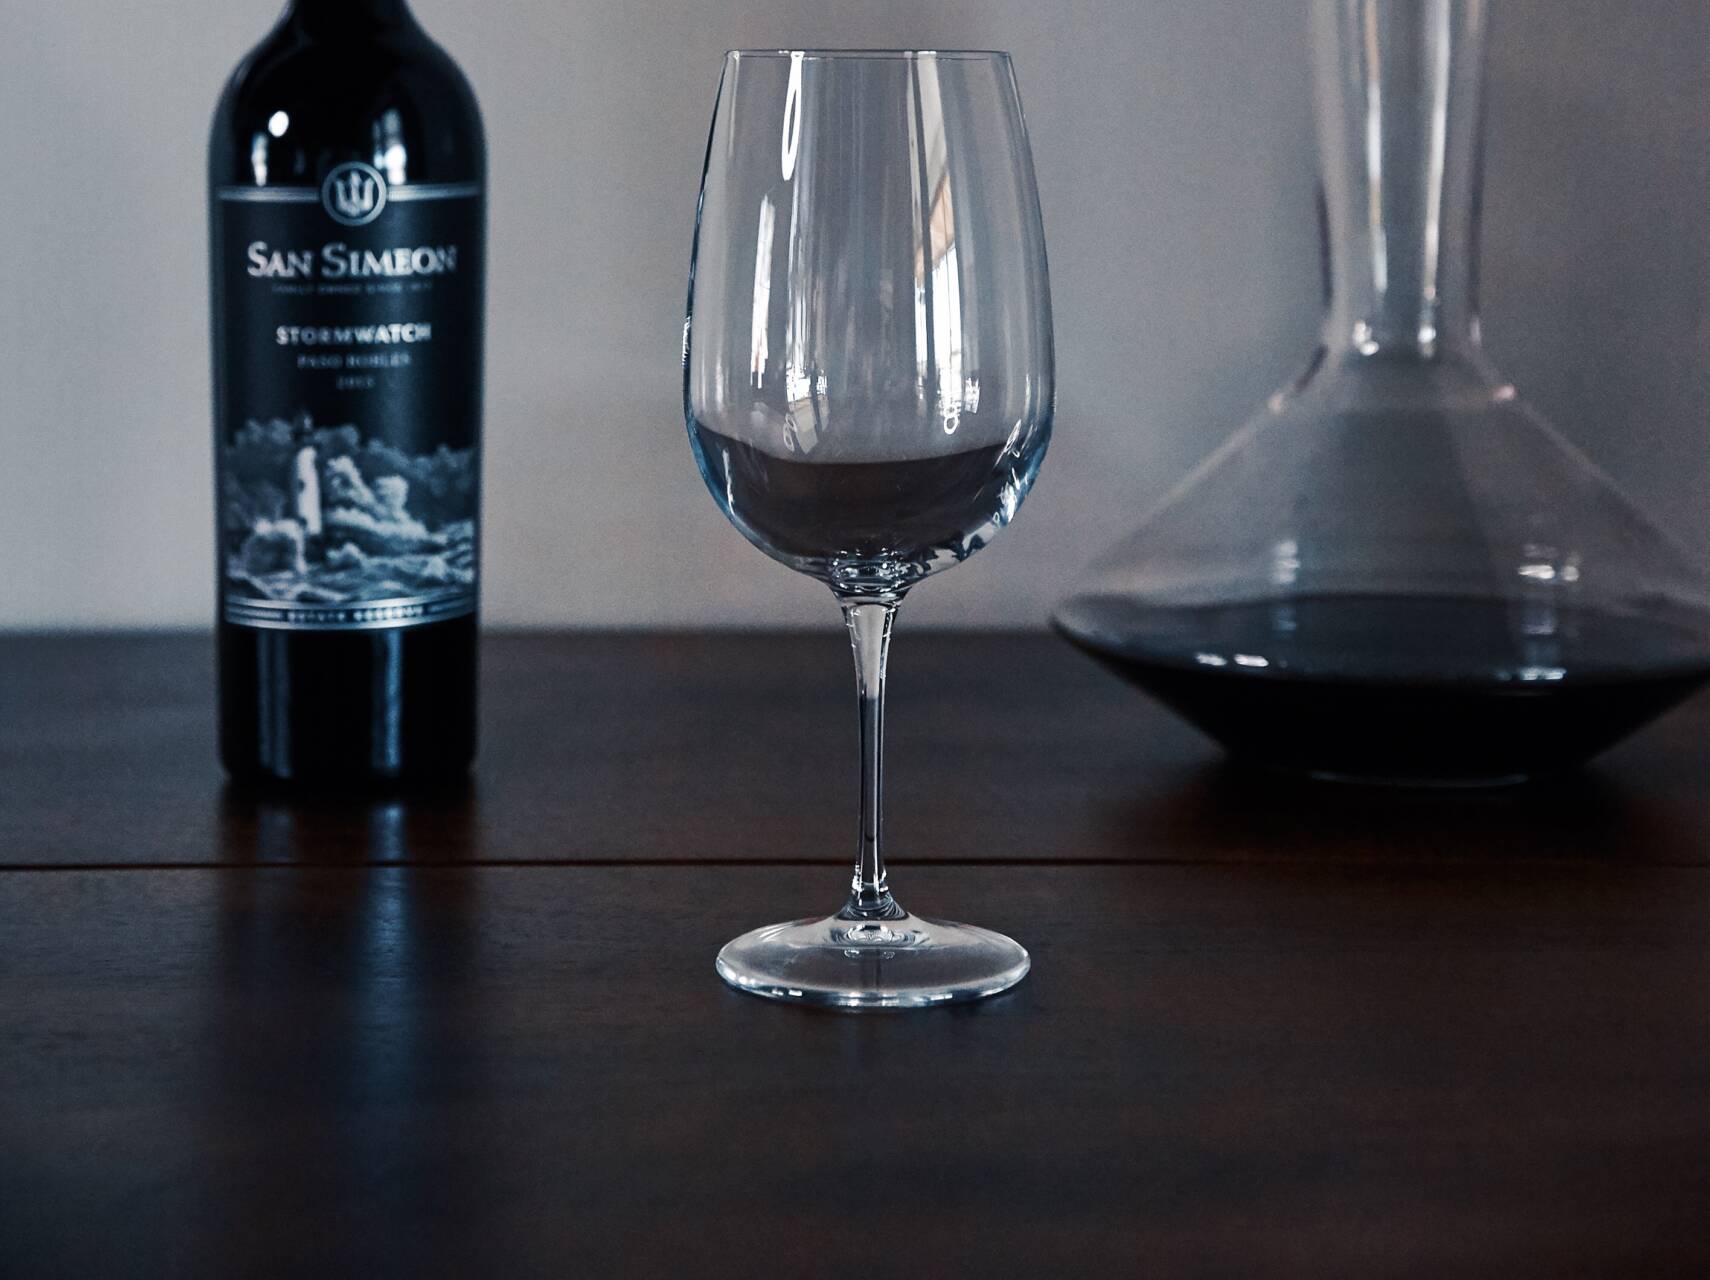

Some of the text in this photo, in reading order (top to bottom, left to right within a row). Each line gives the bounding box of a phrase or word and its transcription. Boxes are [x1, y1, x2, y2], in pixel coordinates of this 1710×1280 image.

[247, 241, 457, 277] SAN SIMEON
[276, 323, 432, 345] STORMWATCH
